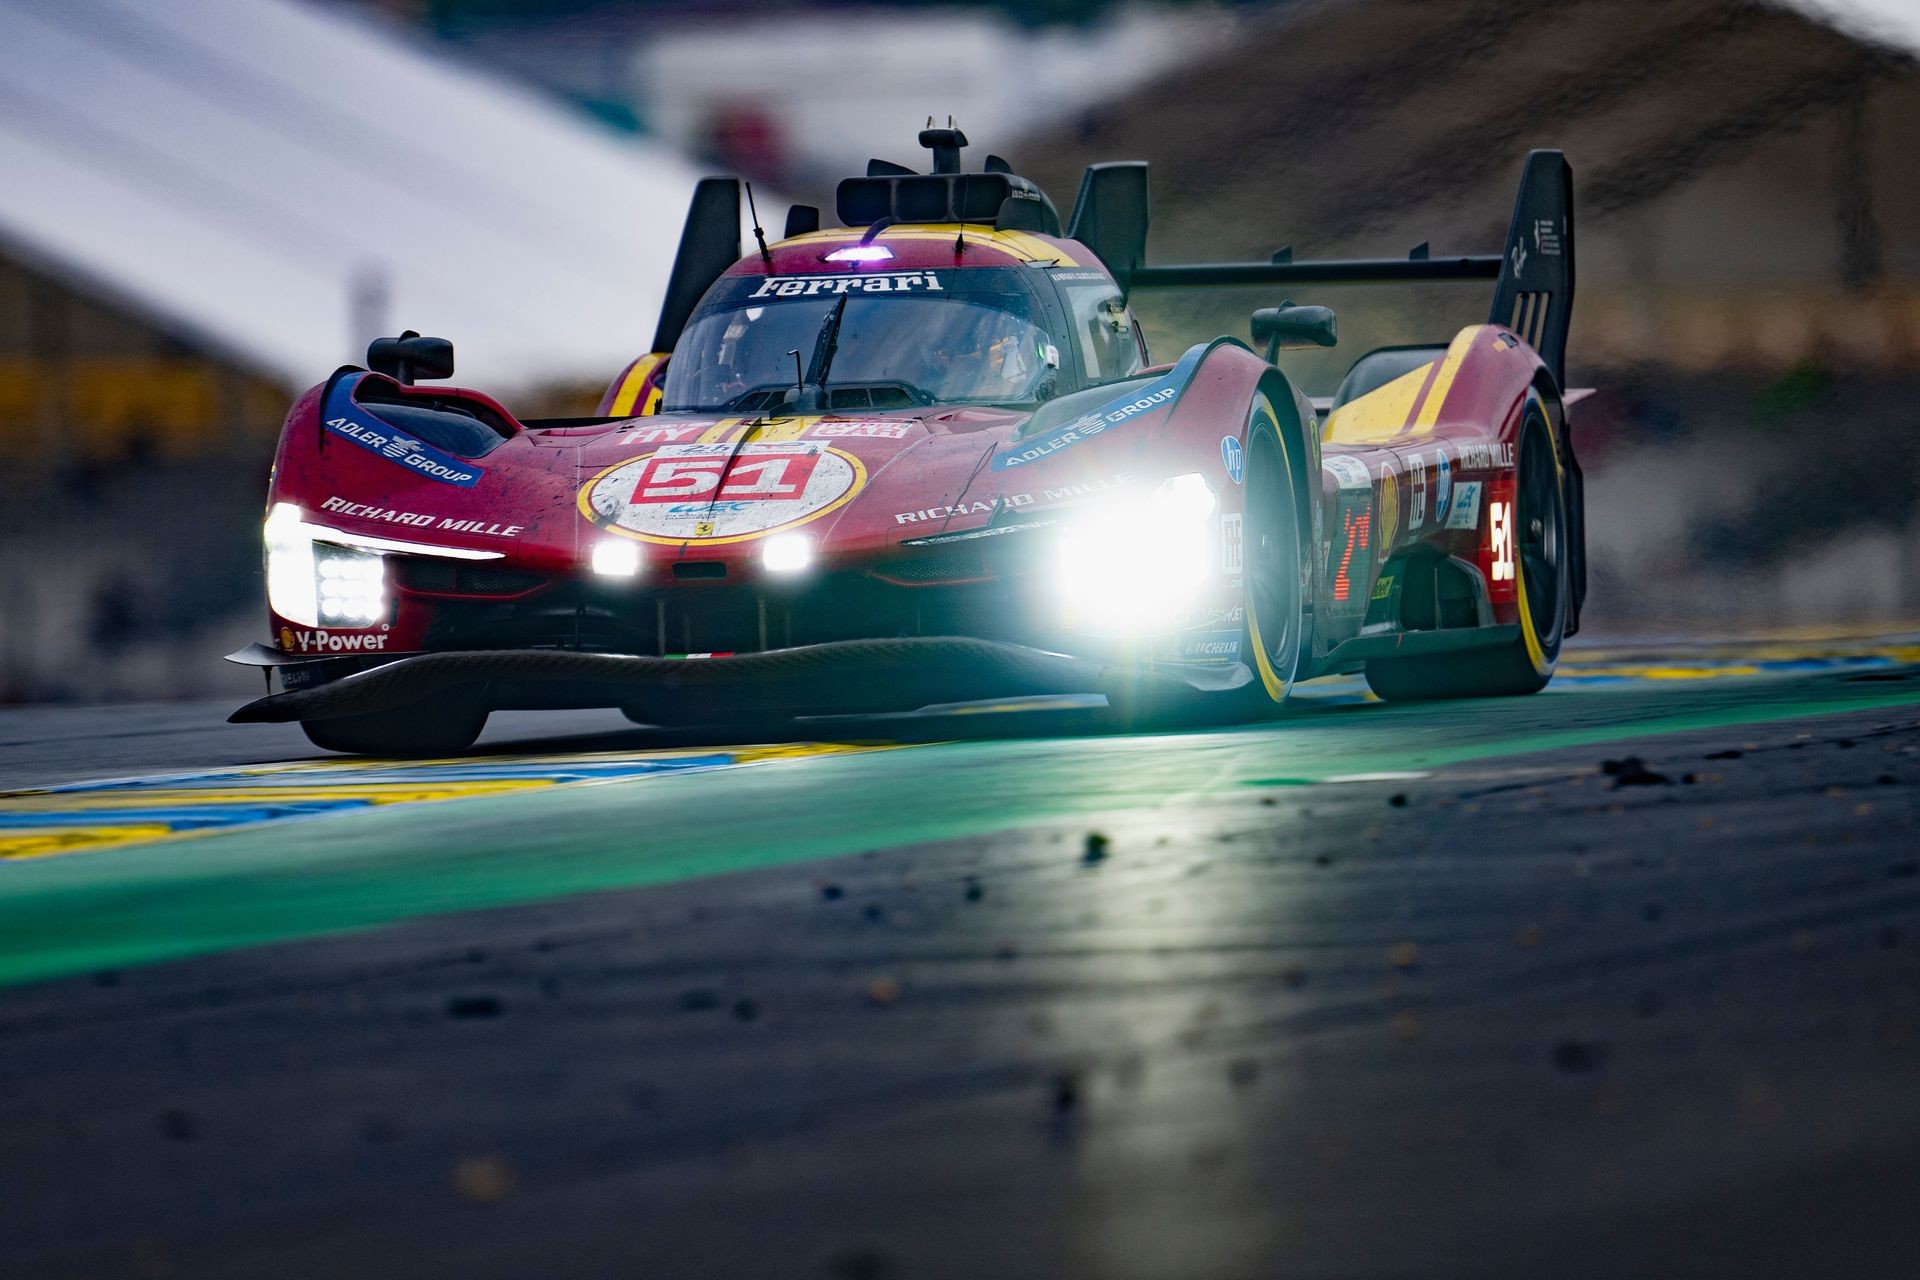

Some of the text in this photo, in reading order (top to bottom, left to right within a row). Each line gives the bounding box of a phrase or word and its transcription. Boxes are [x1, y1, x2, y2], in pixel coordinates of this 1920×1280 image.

[748, 271, 944, 298] Ferrari
[1005, 388, 1176, 467] ADLER GROUP
[326, 417, 473, 483] ADLER GROUP
[1225, 437, 1242, 482] hp
[1458, 443, 1515, 469] RICHARD MILLE
[643, 459, 797, 497] 51
[894, 470, 1137, 525] RICHARD MILLE
[320, 496, 525, 537] RICHARD MILLE
[1490, 502, 1515, 581] 51
[295, 630, 388, 652] V-Power
